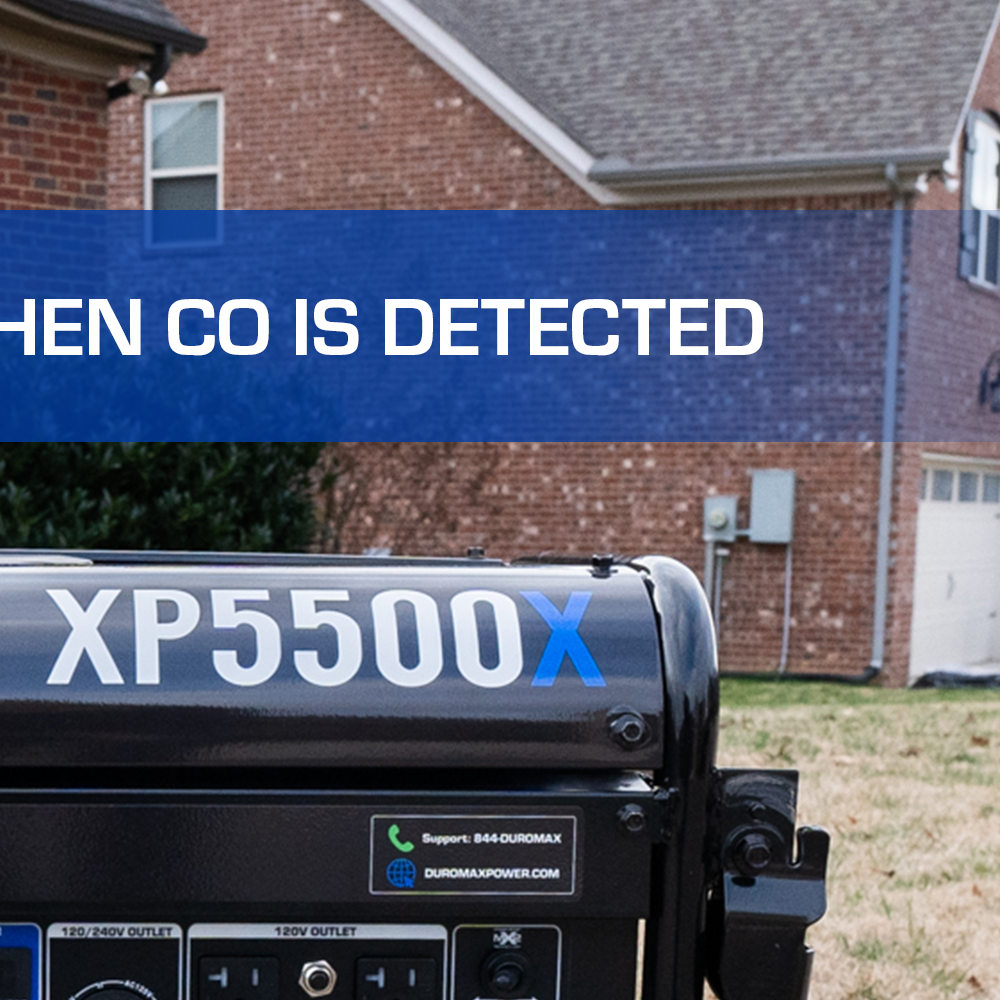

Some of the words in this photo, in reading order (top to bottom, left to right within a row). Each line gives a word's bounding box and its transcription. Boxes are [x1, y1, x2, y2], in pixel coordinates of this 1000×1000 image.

[45, 588, 607, 689] XP5500X
[421, 832, 471, 846] Support:
[473, 832, 562, 844] 844-DUROMAX
[424, 867, 561, 880] DUROMAXPOWER.COM
[61, 926, 125, 938] 120/240V
[127, 926, 173, 937] OUTLET
[275, 926, 308, 937] 120V
[310, 926, 357, 937] OUTLET
